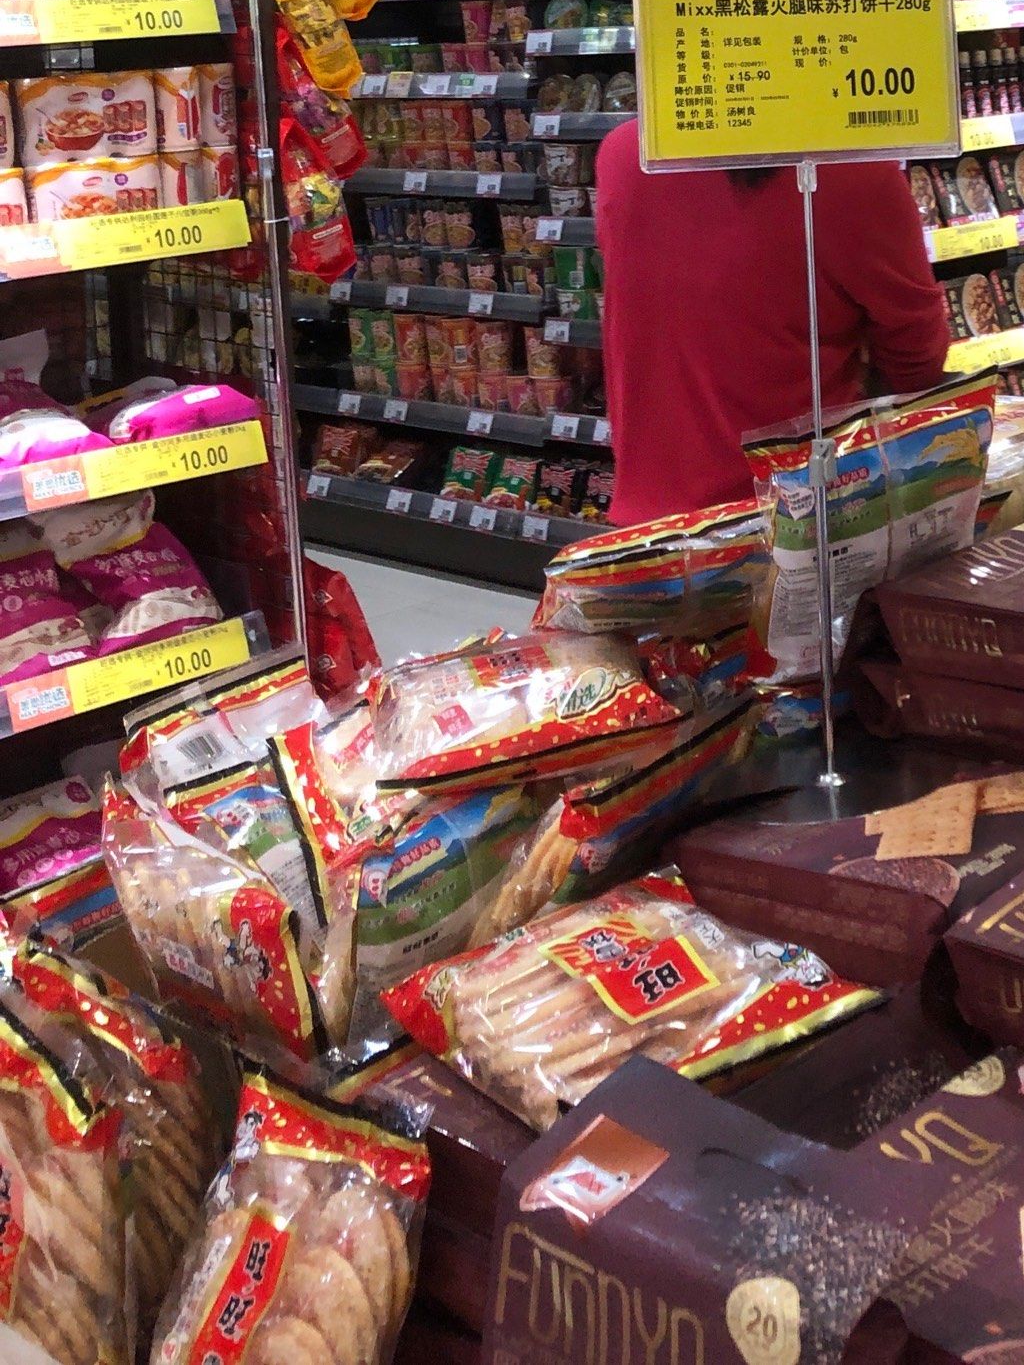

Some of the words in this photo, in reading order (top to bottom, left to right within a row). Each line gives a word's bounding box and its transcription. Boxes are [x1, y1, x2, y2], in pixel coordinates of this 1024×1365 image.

[134, 9, 184, 31] 10.00
[838, 34, 858, 43] 280g
[840, 45, 849, 54] 包
[845, 67, 916, 96] 10.00
[727, 119, 752, 127] 12345
[154, 224, 203, 248] 10.00
[180, 445, 229, 472] 10.00
[164, 648, 212, 679] 10.00
